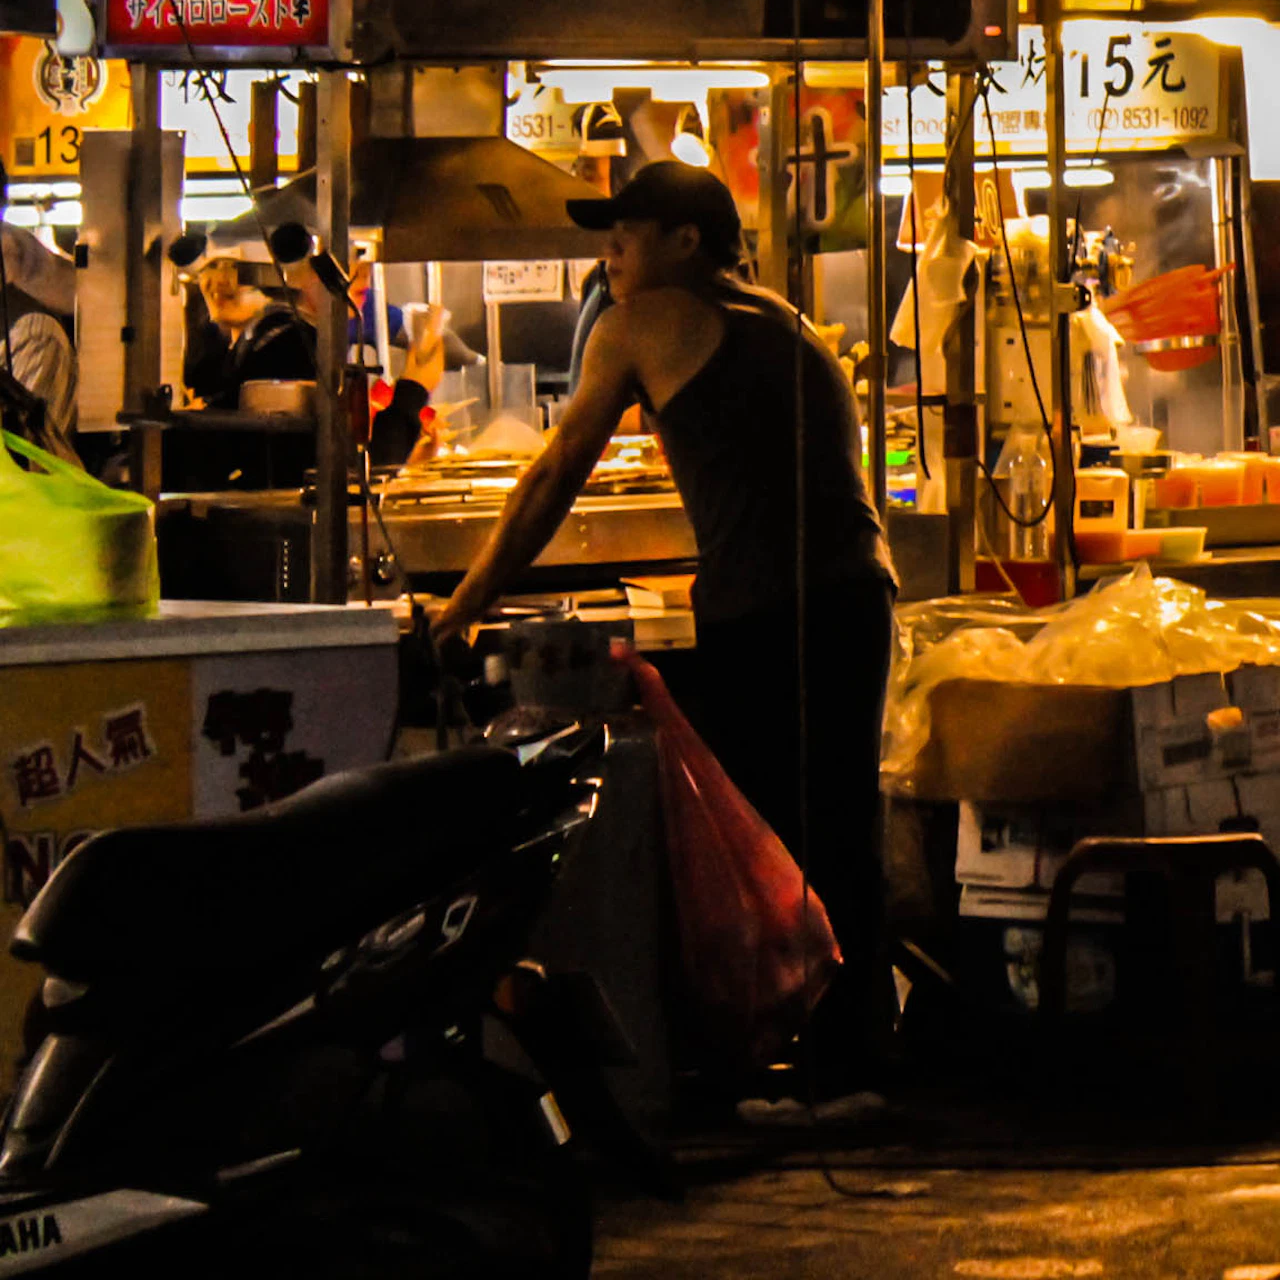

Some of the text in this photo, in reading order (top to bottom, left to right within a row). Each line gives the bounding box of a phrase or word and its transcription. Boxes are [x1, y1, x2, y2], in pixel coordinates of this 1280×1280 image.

[979, 109, 1048, 135] 加盟專
[13, 706, 152, 808] 超人氣
